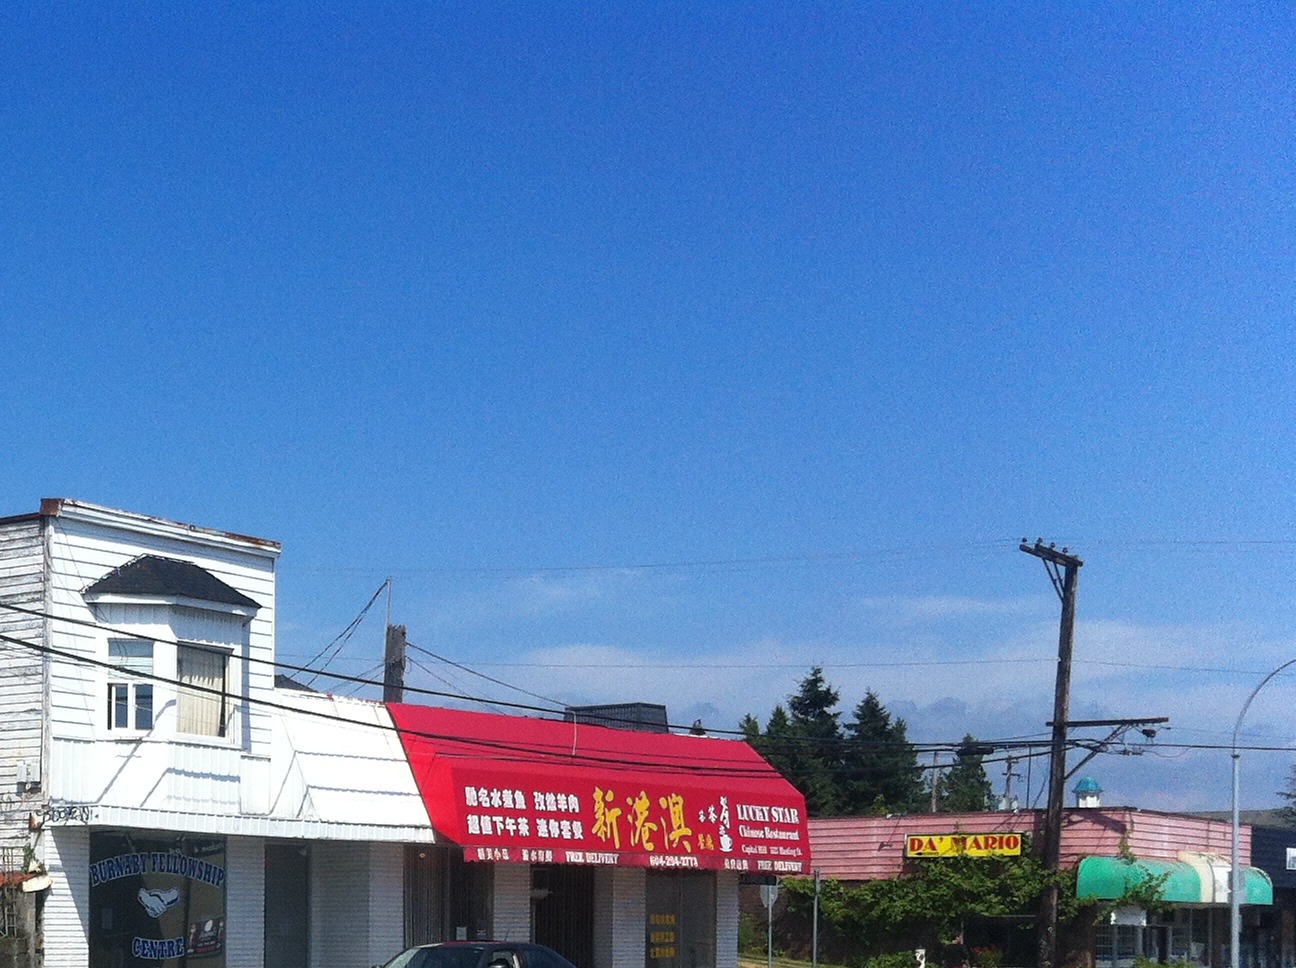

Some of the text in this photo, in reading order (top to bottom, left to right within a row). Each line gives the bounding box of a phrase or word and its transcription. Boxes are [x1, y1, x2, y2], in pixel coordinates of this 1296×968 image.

[736, 804, 769, 822] LUCKY
[771, 806, 799, 824] STAR
[738, 825, 799, 840] Chinese Restaurant
[565, 851, 620, 865] FREE DELIVERY
[757, 860, 773, 871] FREE
[774, 861, 802, 872] DELIVERY
[91, 852, 226, 889] BURNABY FELLOWSHIP
[132, 937, 186, 960] CENTRE
